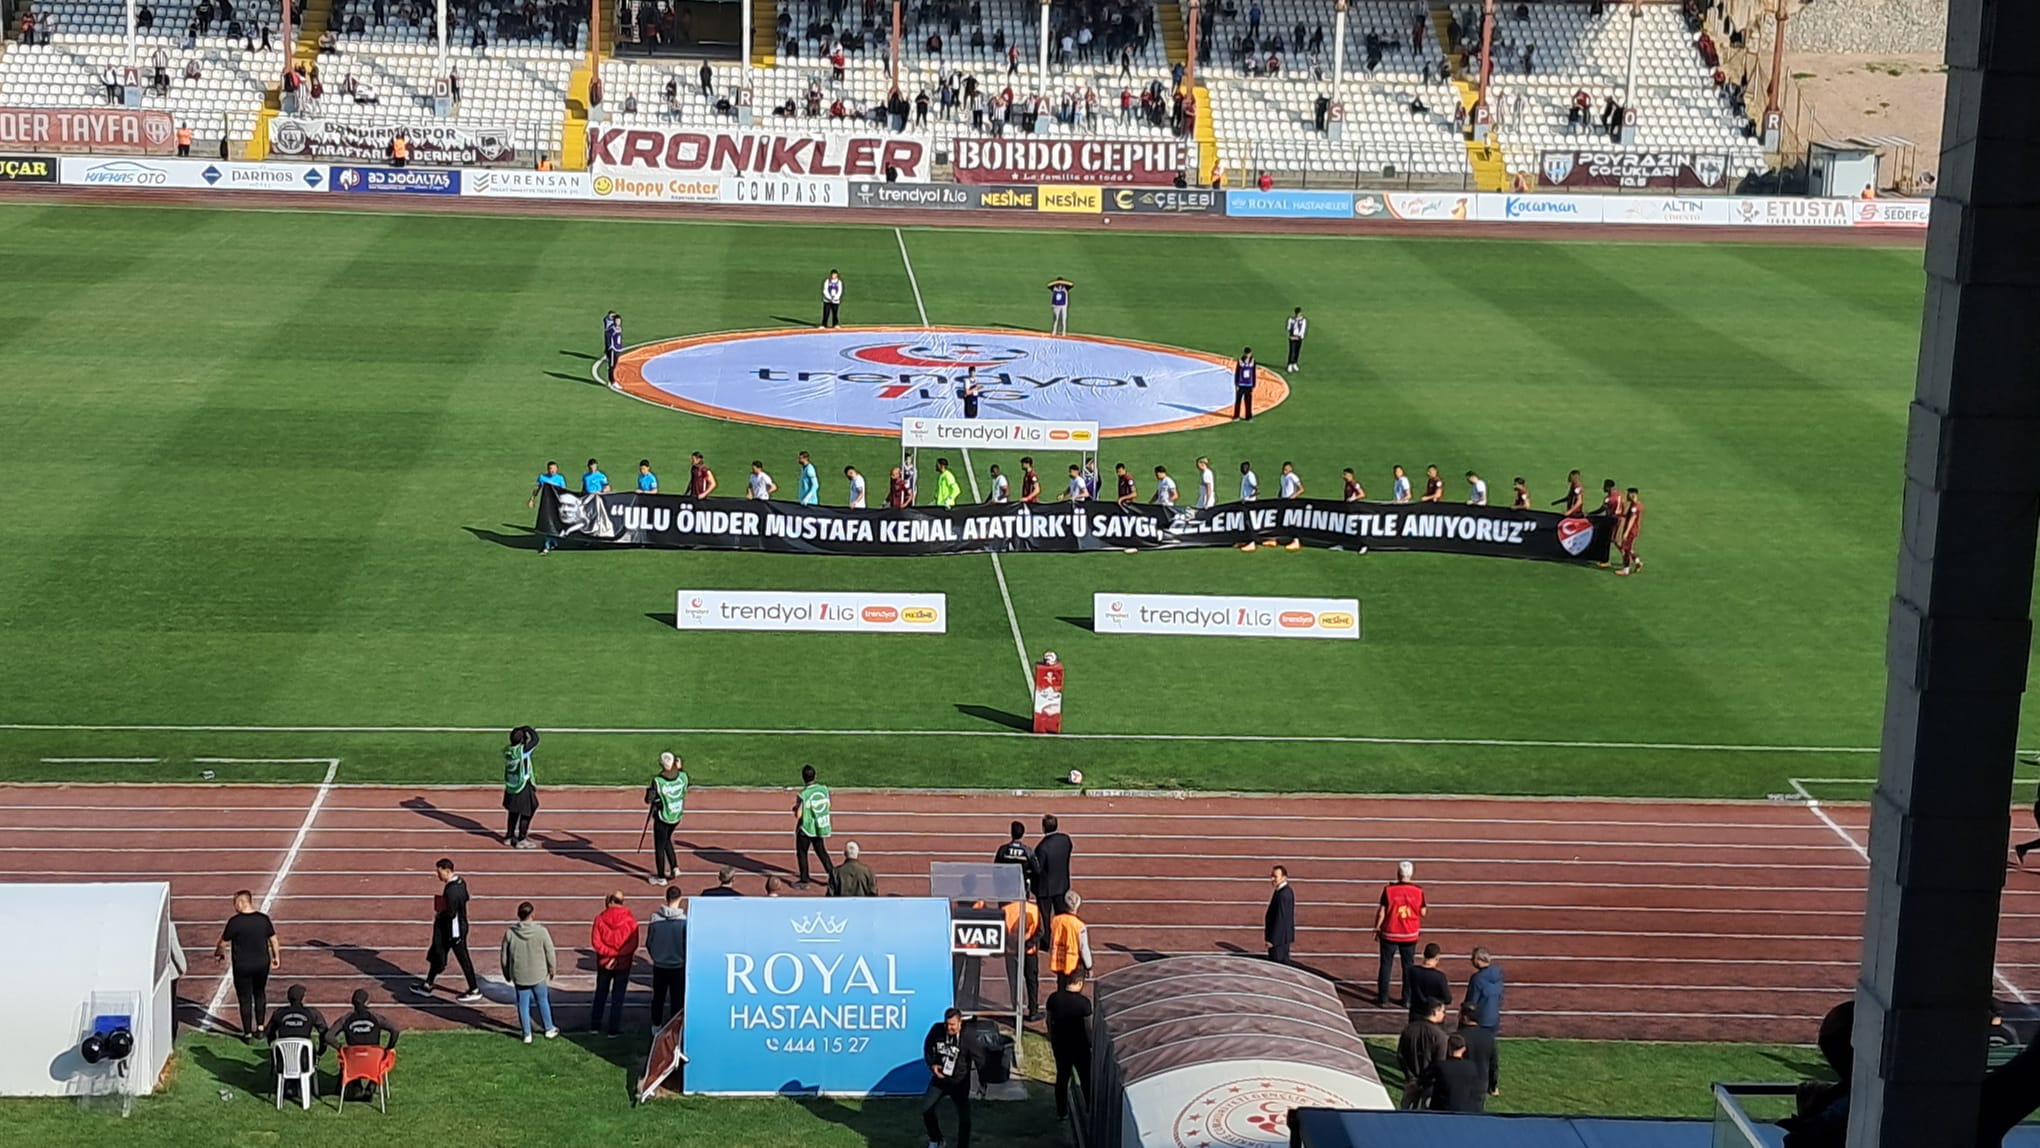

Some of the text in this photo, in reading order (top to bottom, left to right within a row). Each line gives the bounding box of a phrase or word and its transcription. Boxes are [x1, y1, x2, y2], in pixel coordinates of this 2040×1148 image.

[126, 70, 137, 85] A
[437, 81, 448, 96] D
[740, 90, 751, 105] R
[1038, 99, 1049, 114] A
[1331, 106, 1342, 121] S
[1477, 109, 1488, 123] P
[1768, 113, 1780, 128] R
[57, 114, 139, 143] TAYFA
[310, 144, 410, 161] TARAFTARLR
[959, 140, 1186, 172] BORDO CEPHE
[1578, 153, 1690, 166] POYRAZIN
[137, 173, 167, 185] OTO
[490, 174, 580, 187] EVRENSAN
[614, 177, 720, 198] Happy Center
[736, 180, 832, 203] COMPASS
[878, 186, 940, 205] trendyol
[1248, 199, 1288, 209] ROYAL
[1766, 201, 1847, 217] ETUSTA
[937, 424, 1009, 442] trendyol
[675, 504, 760, 537] ÖNDER
[763, 514, 875, 543] MUSTAFA
[879, 517, 958, 543] KEMAL
[1250, 511, 1277, 529] VE
[1282, 508, 1398, 538] MİNNETLE
[720, 601, 812, 623] trendyol
[1139, 604, 1231, 628] trendyol
[957, 927, 1000, 945] VAR
[724, 952, 917, 995] ROYAL
[730, 999, 908, 1030] HASTANELERİ
[782, 1036, 871, 1053] 444 15 27
